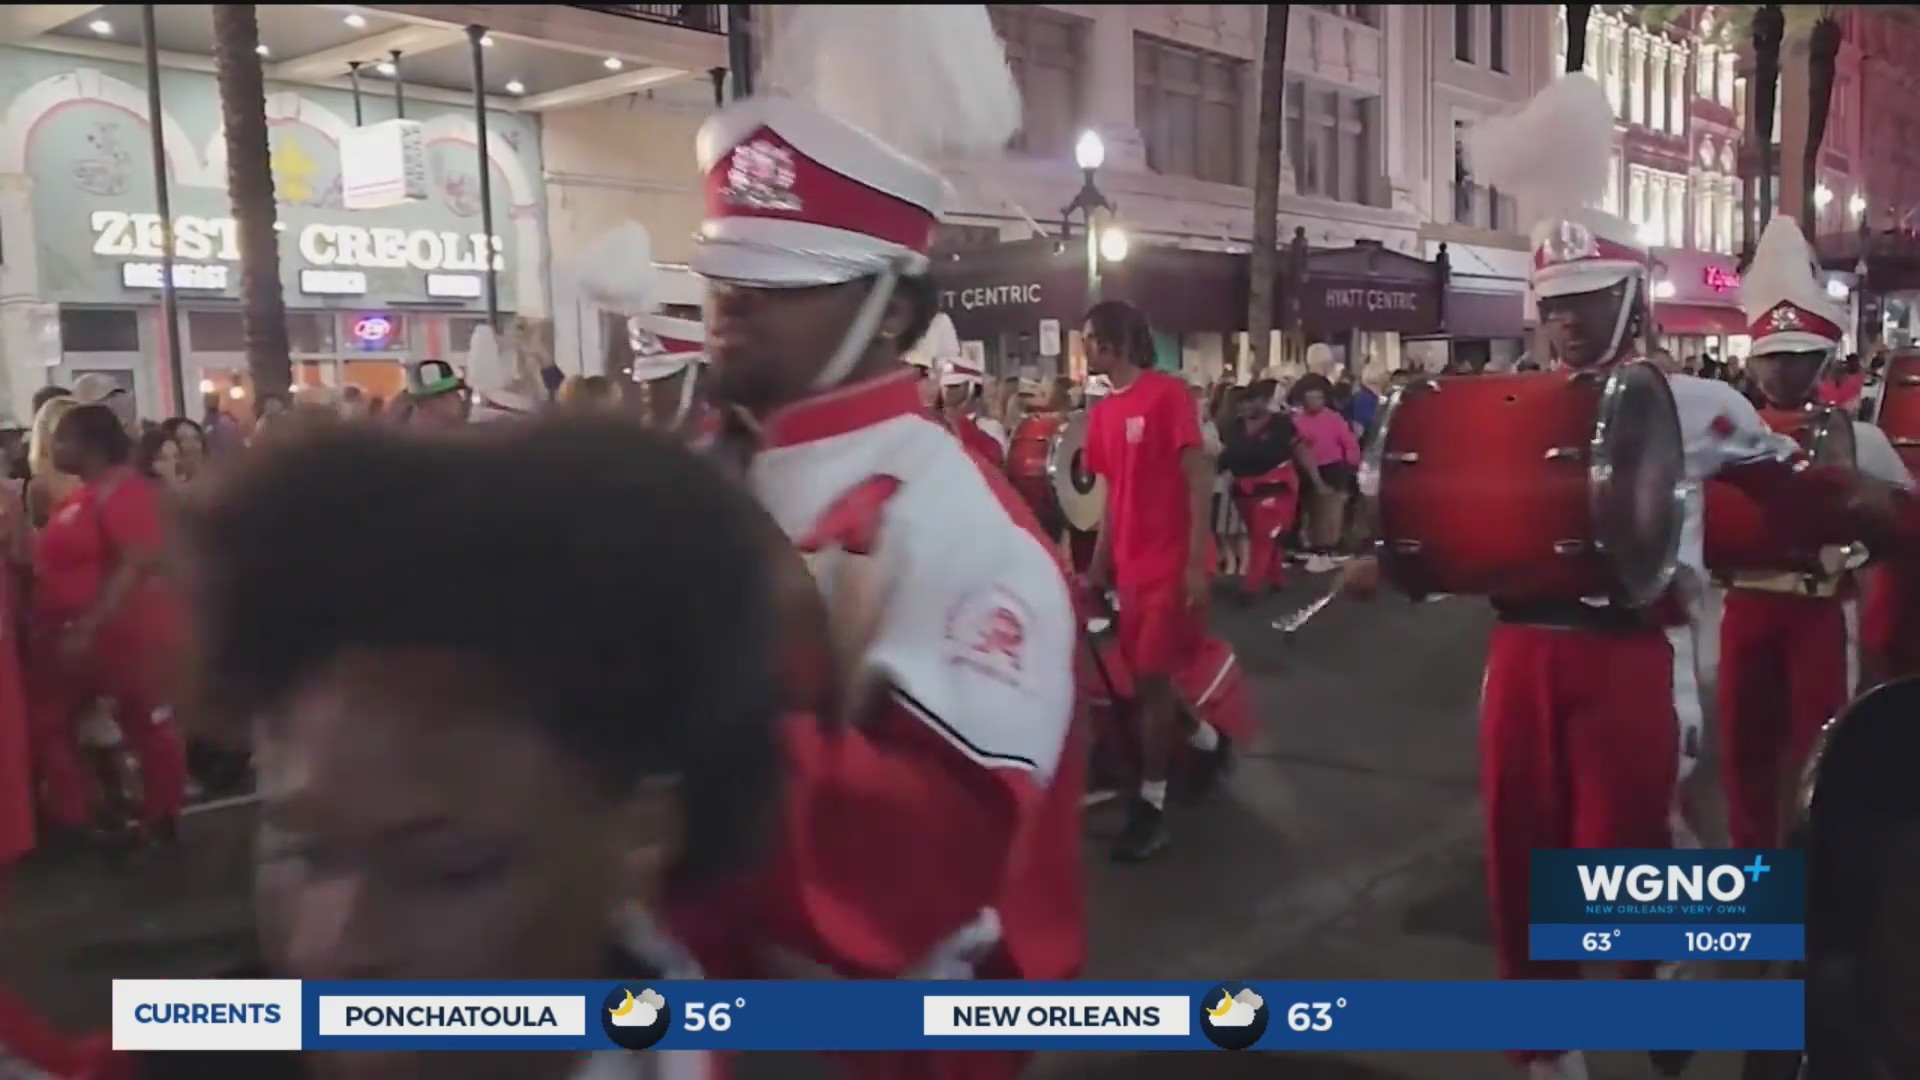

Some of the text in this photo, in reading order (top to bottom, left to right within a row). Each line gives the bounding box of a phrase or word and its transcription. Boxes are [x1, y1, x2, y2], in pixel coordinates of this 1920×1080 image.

[91, 211, 505, 271] ZEST CREOLE
[960, 283, 1042, 310] CENTRIC
[1326, 288, 1417, 311] HYATT CENTRIC
